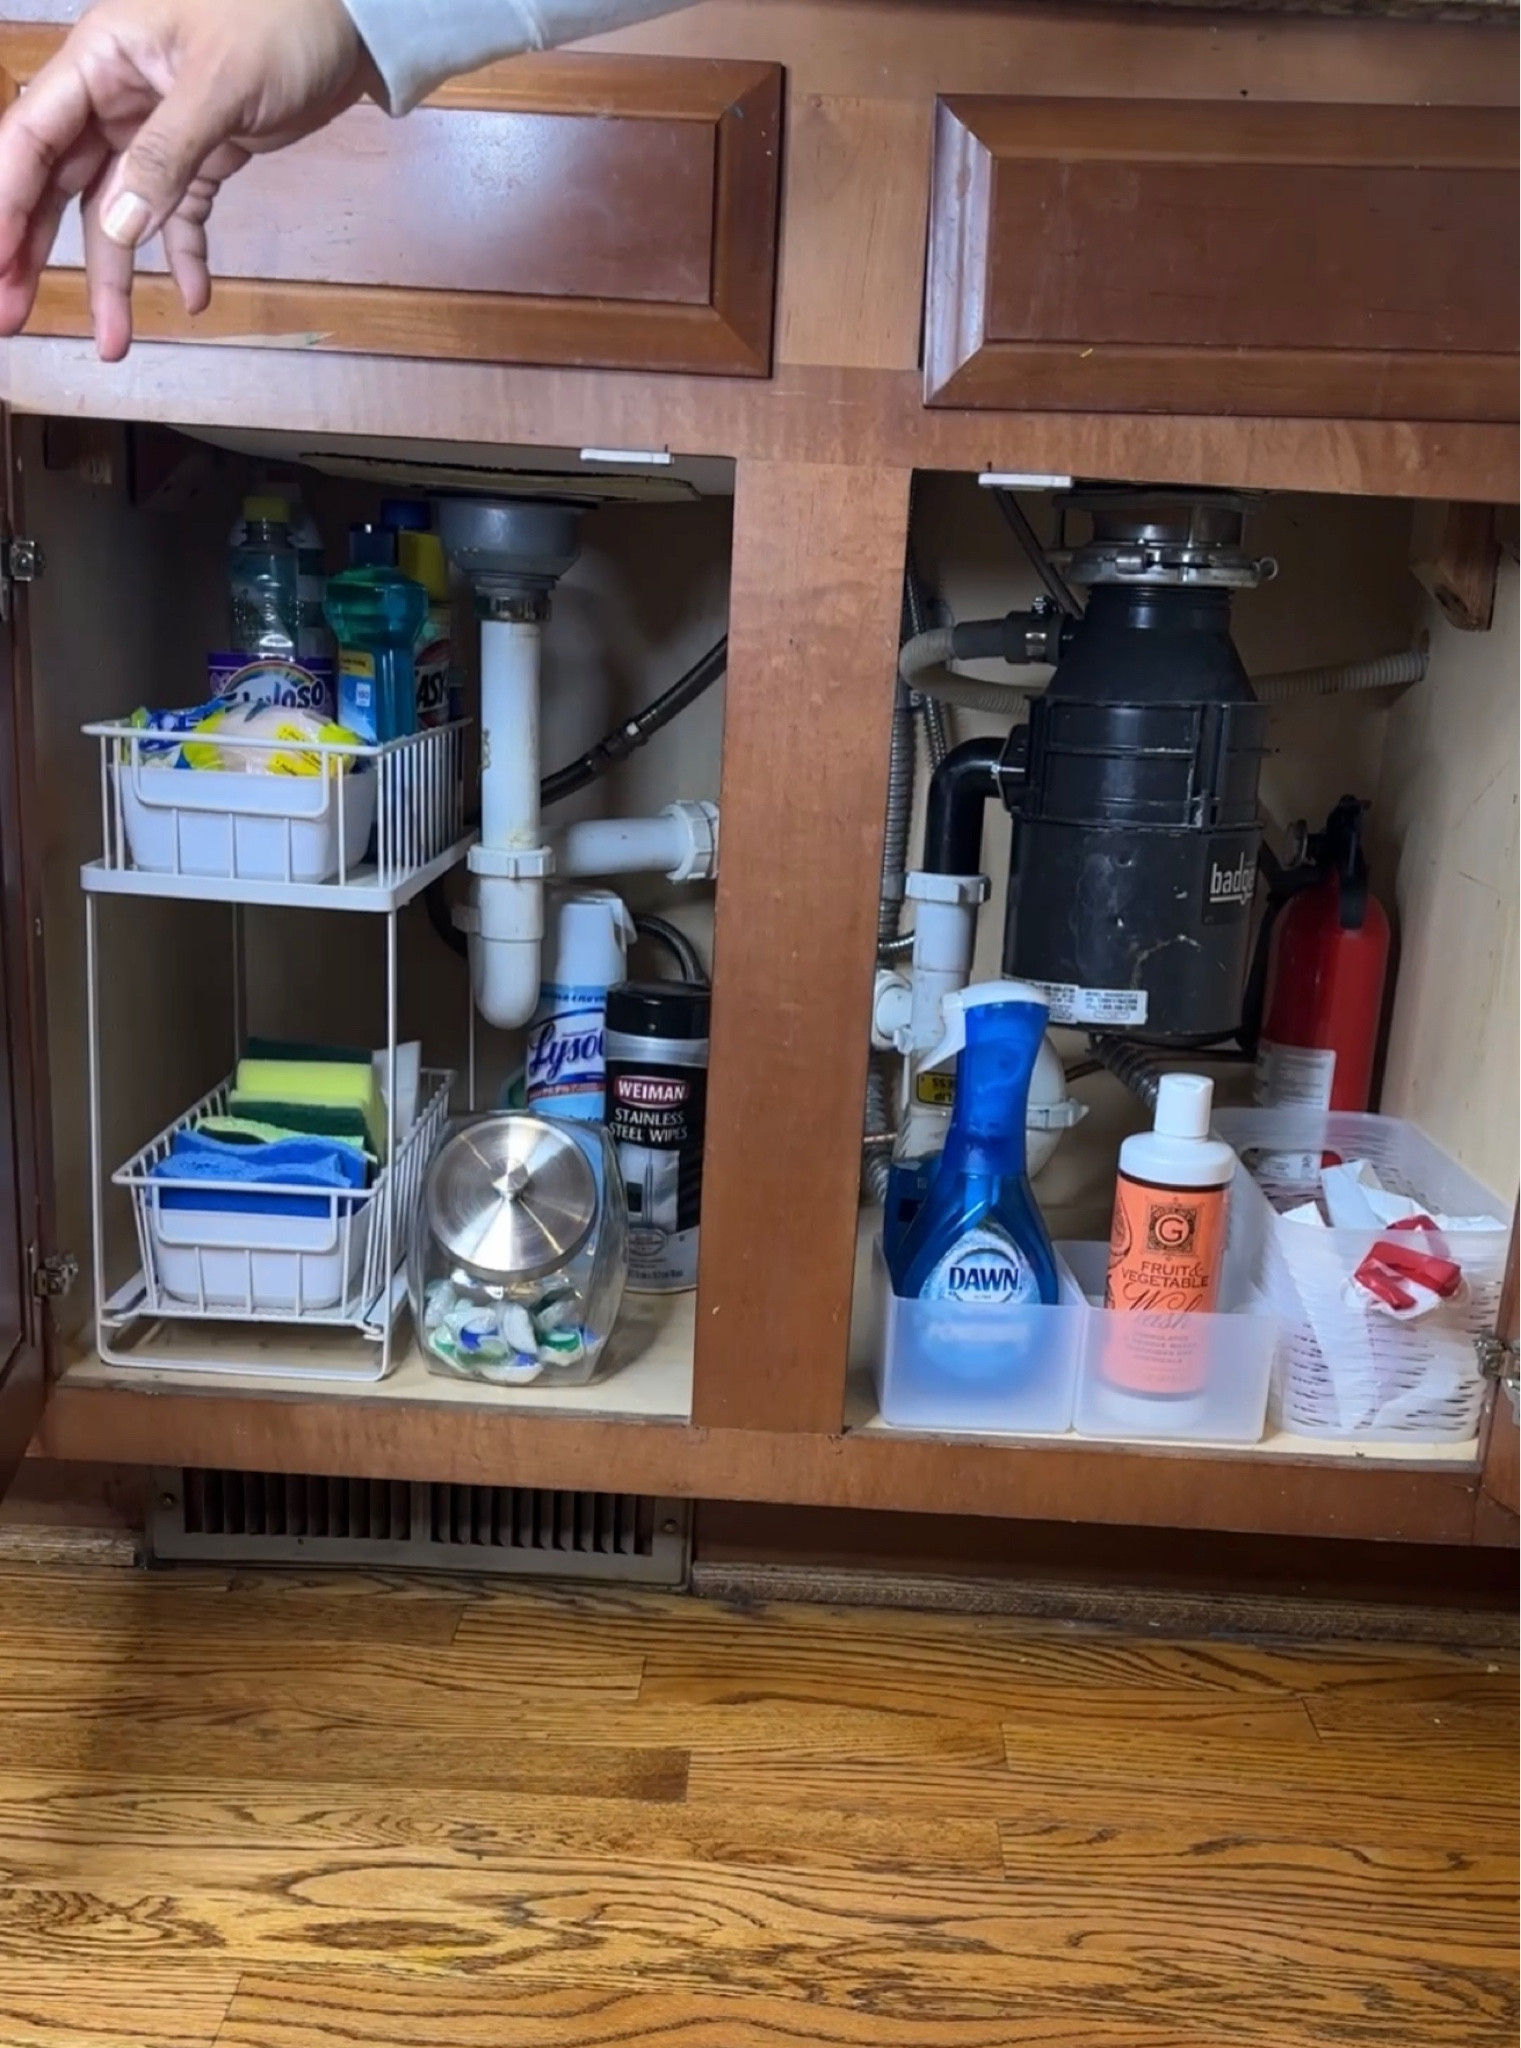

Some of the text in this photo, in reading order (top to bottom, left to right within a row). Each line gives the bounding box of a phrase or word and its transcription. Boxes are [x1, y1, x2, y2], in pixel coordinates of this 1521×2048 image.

[618, 1080, 685, 1101] WEIMAN
[615, 1108, 684, 1126] STAINLESS
[609, 1122, 688, 1142] STEEL WIPES
[1159, 1216, 1185, 1243] G
[948, 1266, 1019, 1292] DAWN
[1121, 1267, 1210, 1289] VEGETABLE
